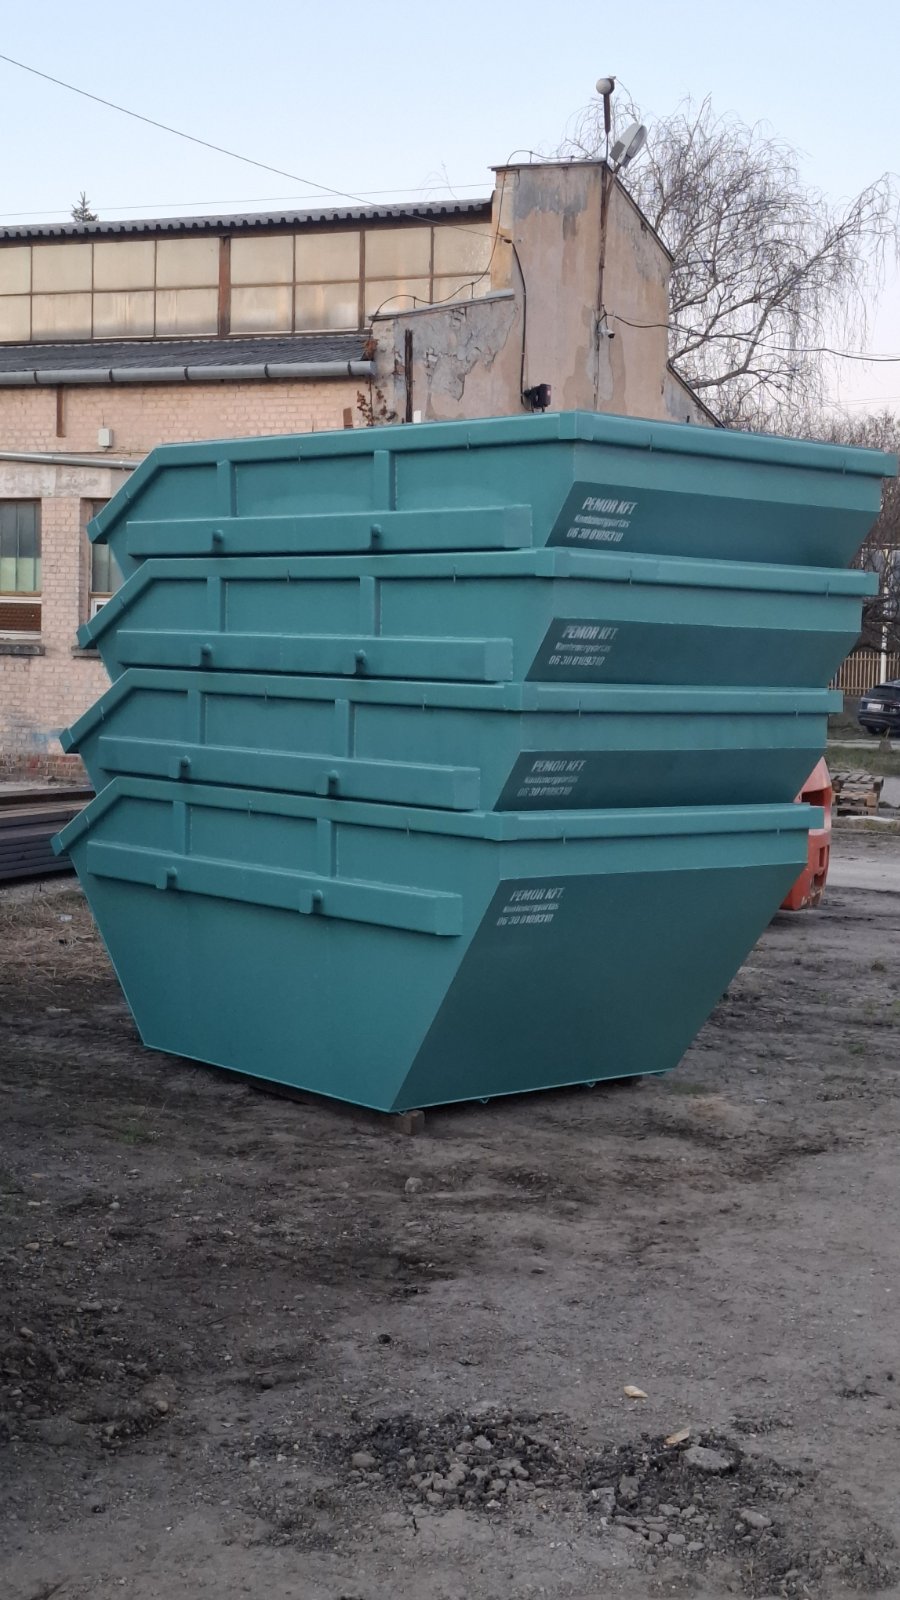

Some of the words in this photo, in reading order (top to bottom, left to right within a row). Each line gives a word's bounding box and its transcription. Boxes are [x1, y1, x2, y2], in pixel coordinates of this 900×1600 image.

[566, 527, 580, 538] 06
[577, 528, 592, 540] 30
[548, 655, 562, 665] 06
